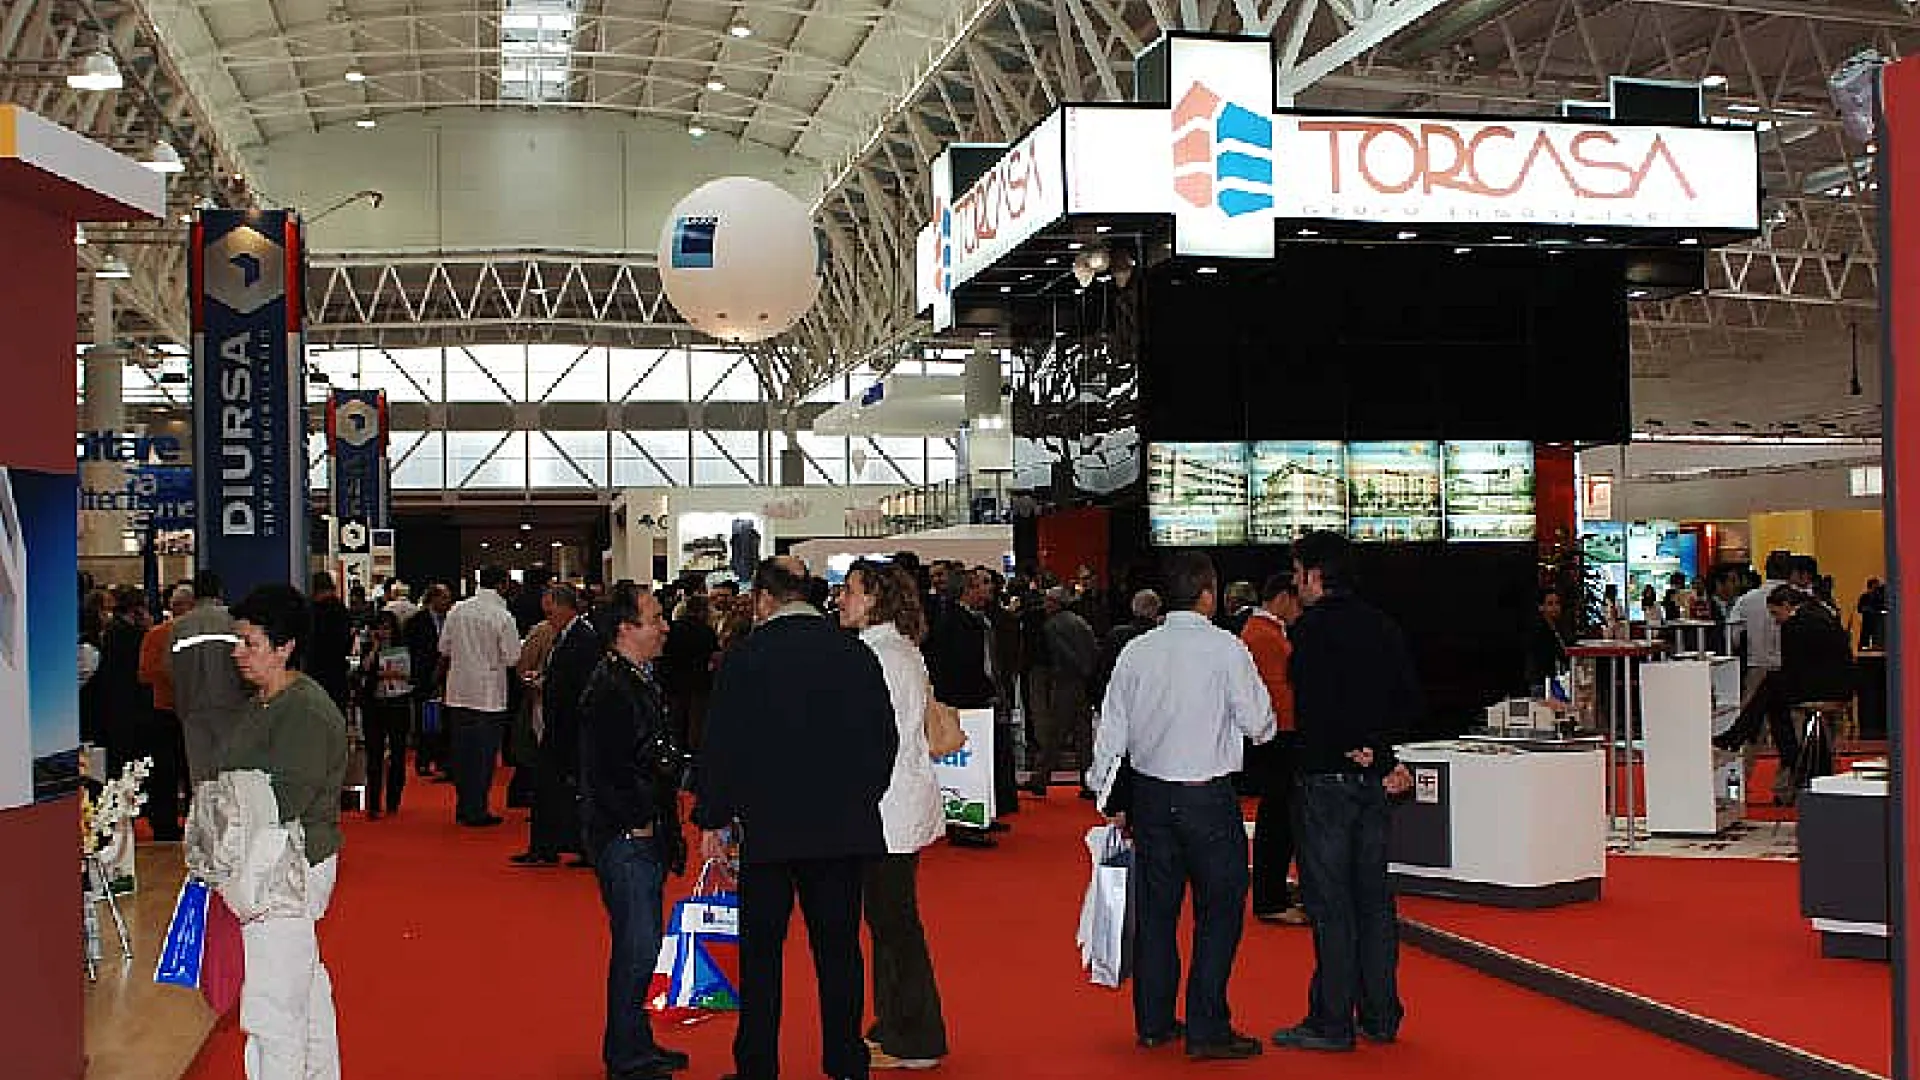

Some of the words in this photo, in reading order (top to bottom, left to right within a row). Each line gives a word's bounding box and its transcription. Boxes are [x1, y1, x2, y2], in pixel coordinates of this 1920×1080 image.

[953, 138, 1043, 264] TORCASA
[1298, 121, 1698, 200] TORCASA
[222, 330, 254, 535] DIURSA
